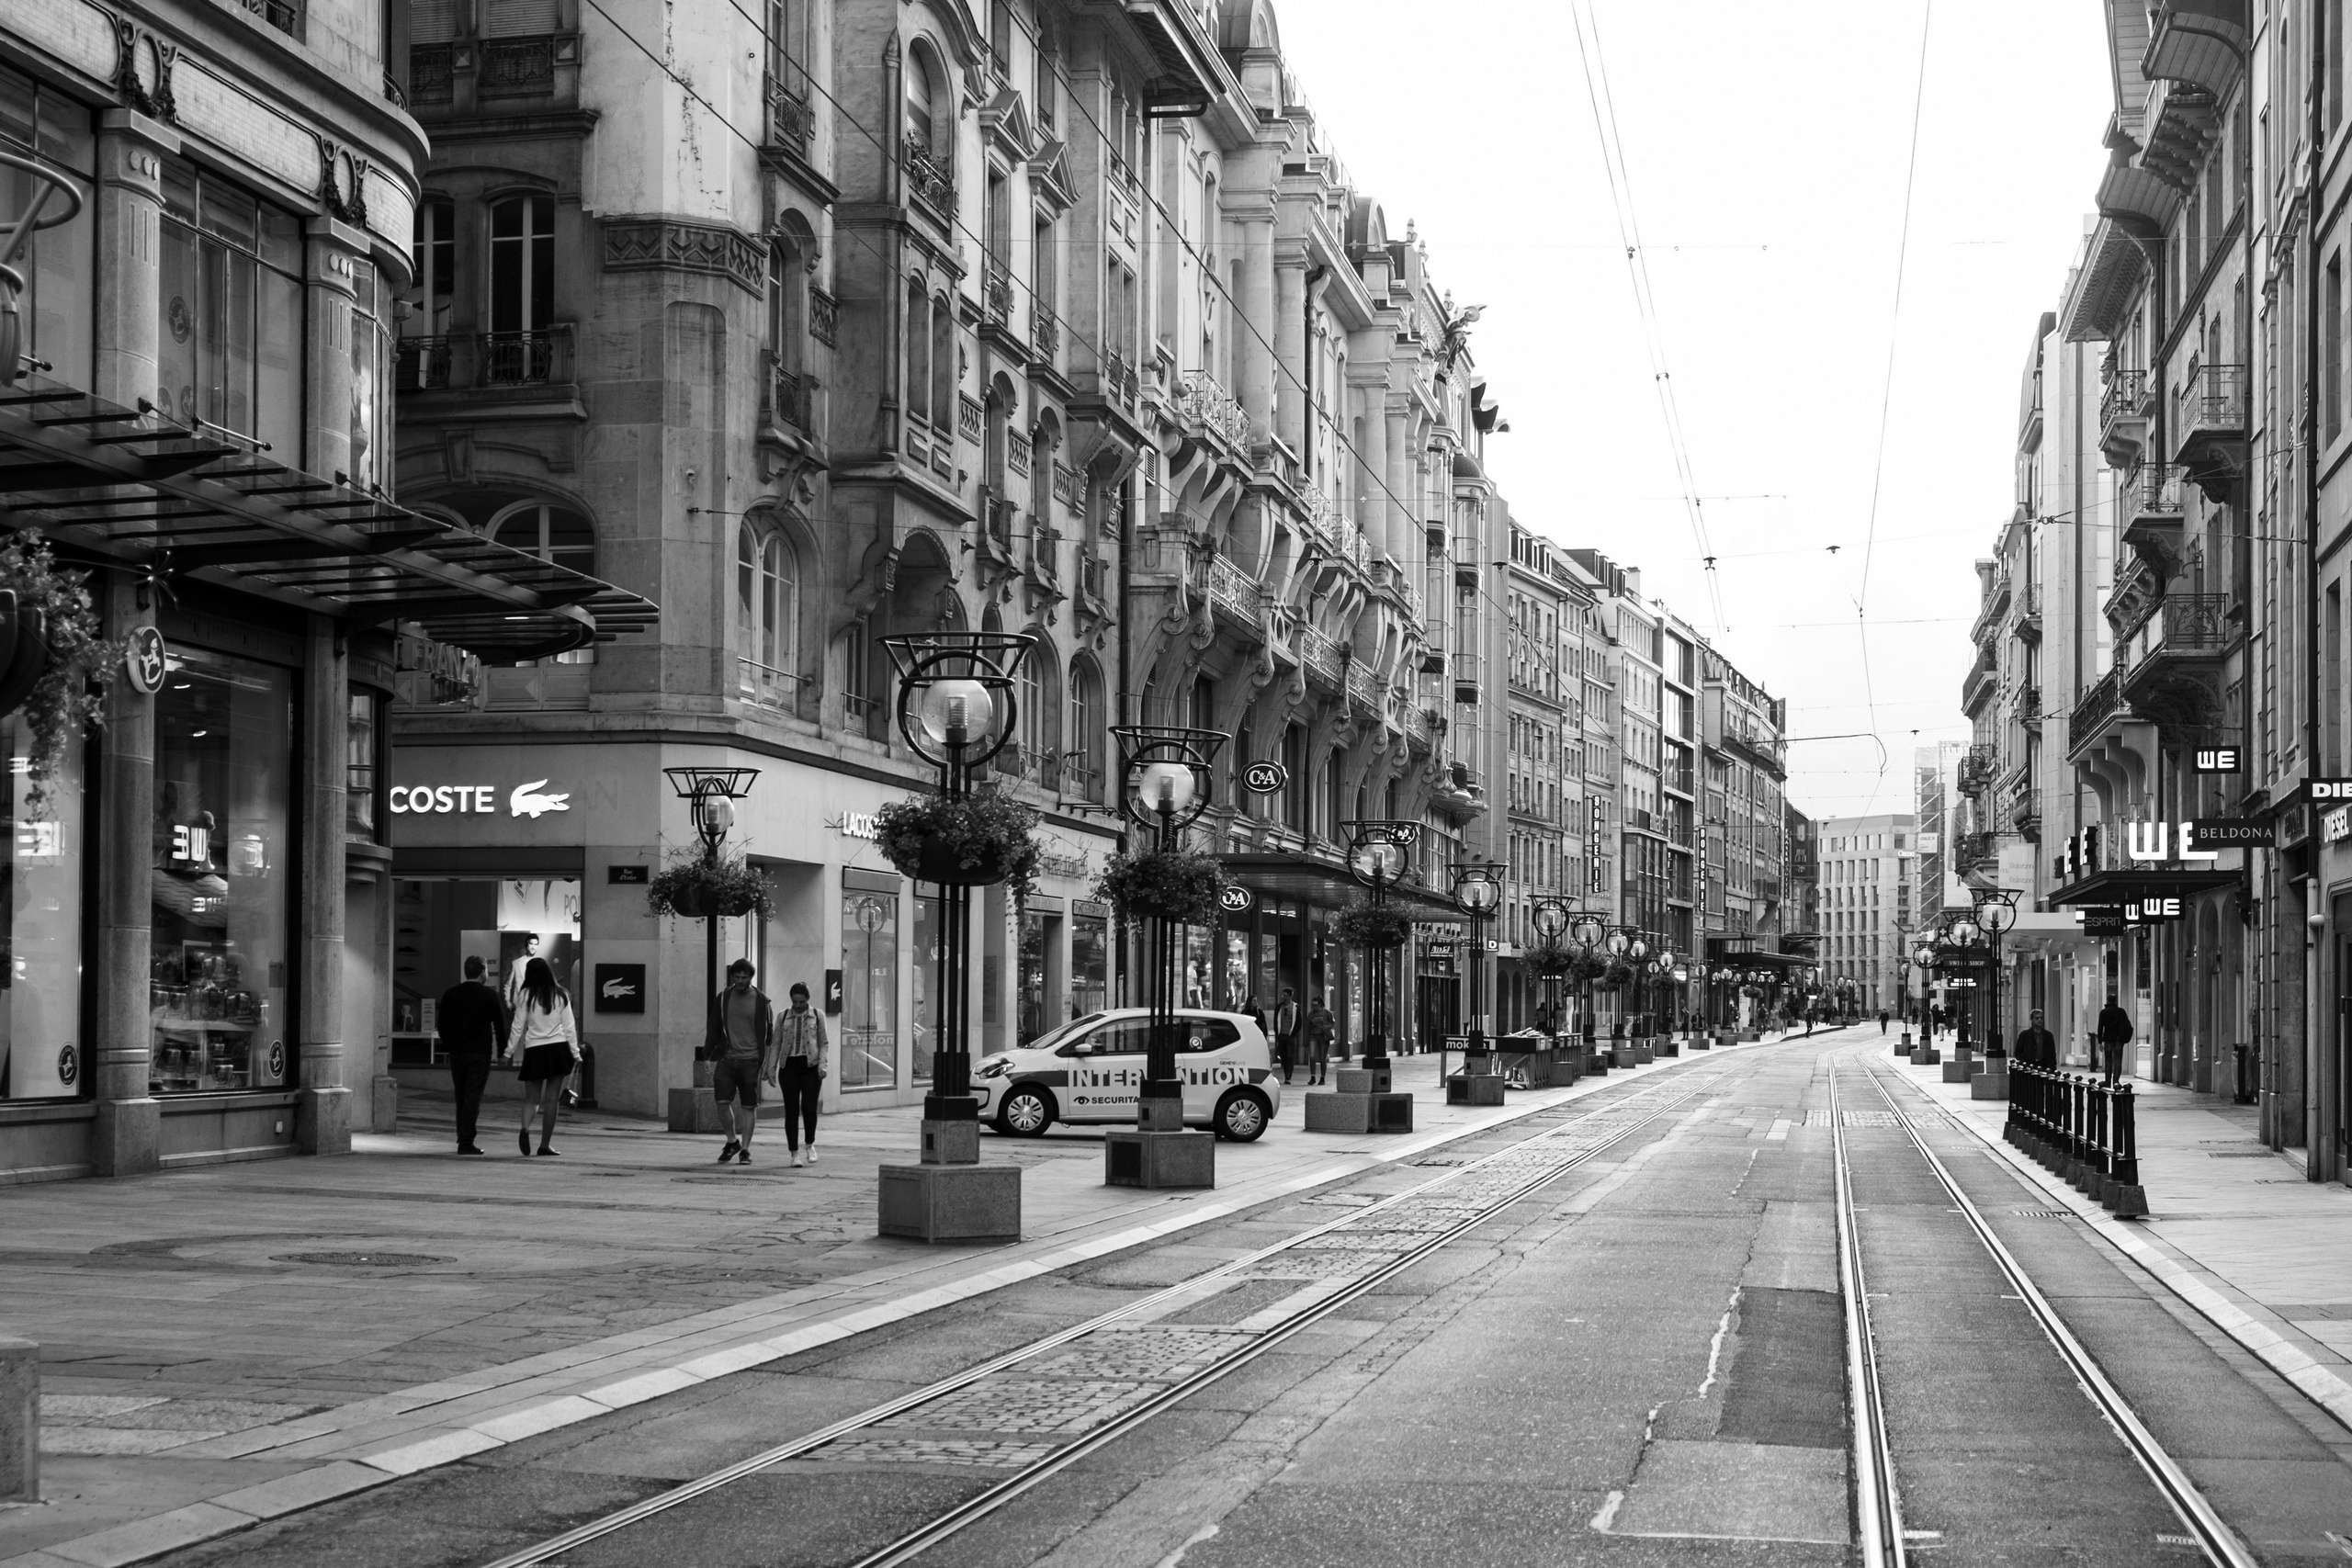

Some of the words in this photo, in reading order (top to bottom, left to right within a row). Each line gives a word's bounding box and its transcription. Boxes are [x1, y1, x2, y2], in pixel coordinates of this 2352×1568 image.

[2197, 750, 2235, 769] WE
[1249, 770, 1277, 785] C&A
[2199, 828, 2273, 840] BELDONA
[2324, 807, 2349, 844] DIESEL
[2128, 821, 2219, 861] WE
[2143, 897, 2180, 916] WE
[2086, 917, 2121, 927] ESPRIT
[1068, 1067, 1250, 1088] INTERNTION
